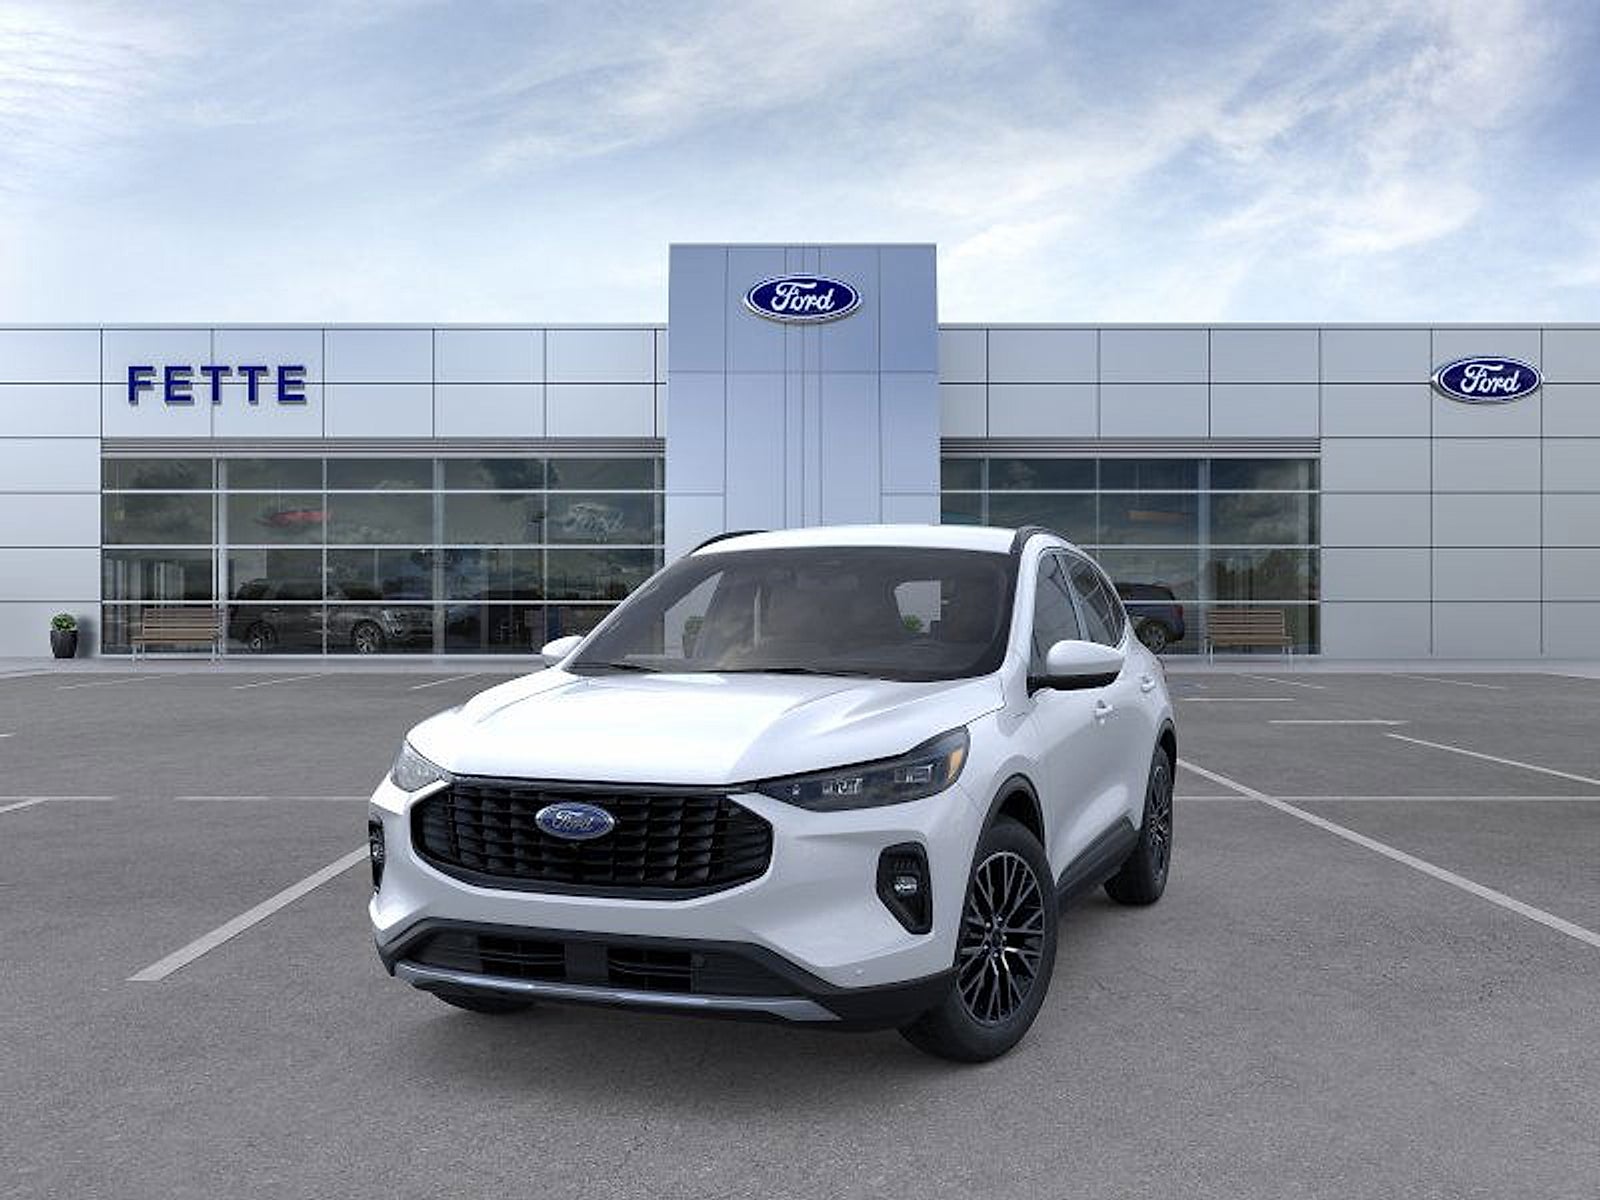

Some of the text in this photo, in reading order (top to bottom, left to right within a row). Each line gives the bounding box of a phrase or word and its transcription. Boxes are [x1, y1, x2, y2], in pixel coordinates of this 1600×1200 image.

[771, 281, 835, 311] Ford
[128, 365, 307, 405] FETTE
[1460, 363, 1521, 393] Ford
[552, 810, 596, 829] Ford
